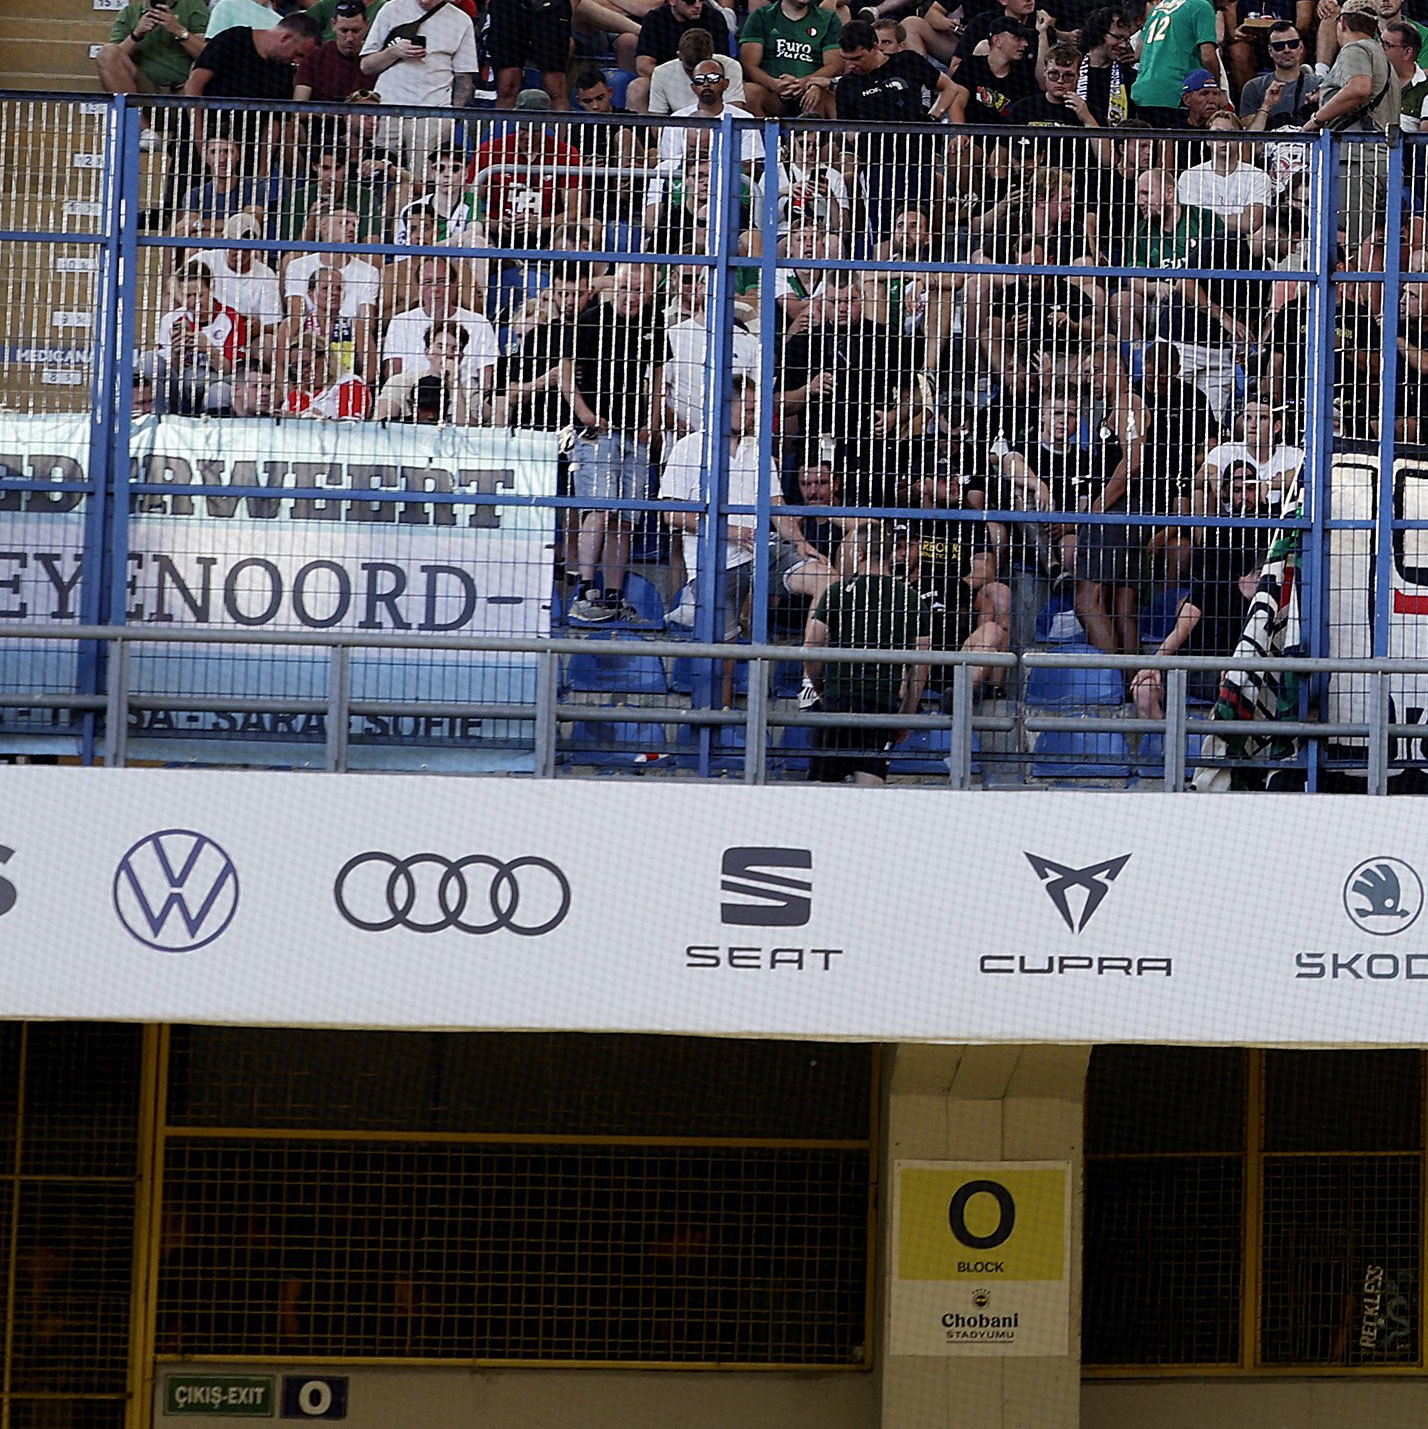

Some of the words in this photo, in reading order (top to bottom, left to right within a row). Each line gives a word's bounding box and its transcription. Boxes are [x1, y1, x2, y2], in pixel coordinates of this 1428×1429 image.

[1145, 16, 1174, 44] 12
[776, 38, 812, 54] Euro
[0, 454, 513, 527] DRWEERT
[685, 945, 843, 972] SEAT
[979, 954, 1173, 978] CUPRA
[948, 1179, 1016, 1250] O
[956, 1260, 1004, 1274] BLOCK
[941, 1312, 1019, 1329] Chobani
[945, 1330, 1015, 1340] STADYUMU
[175, 1384, 266, 1410] ÇIKIŞ-EXIT
